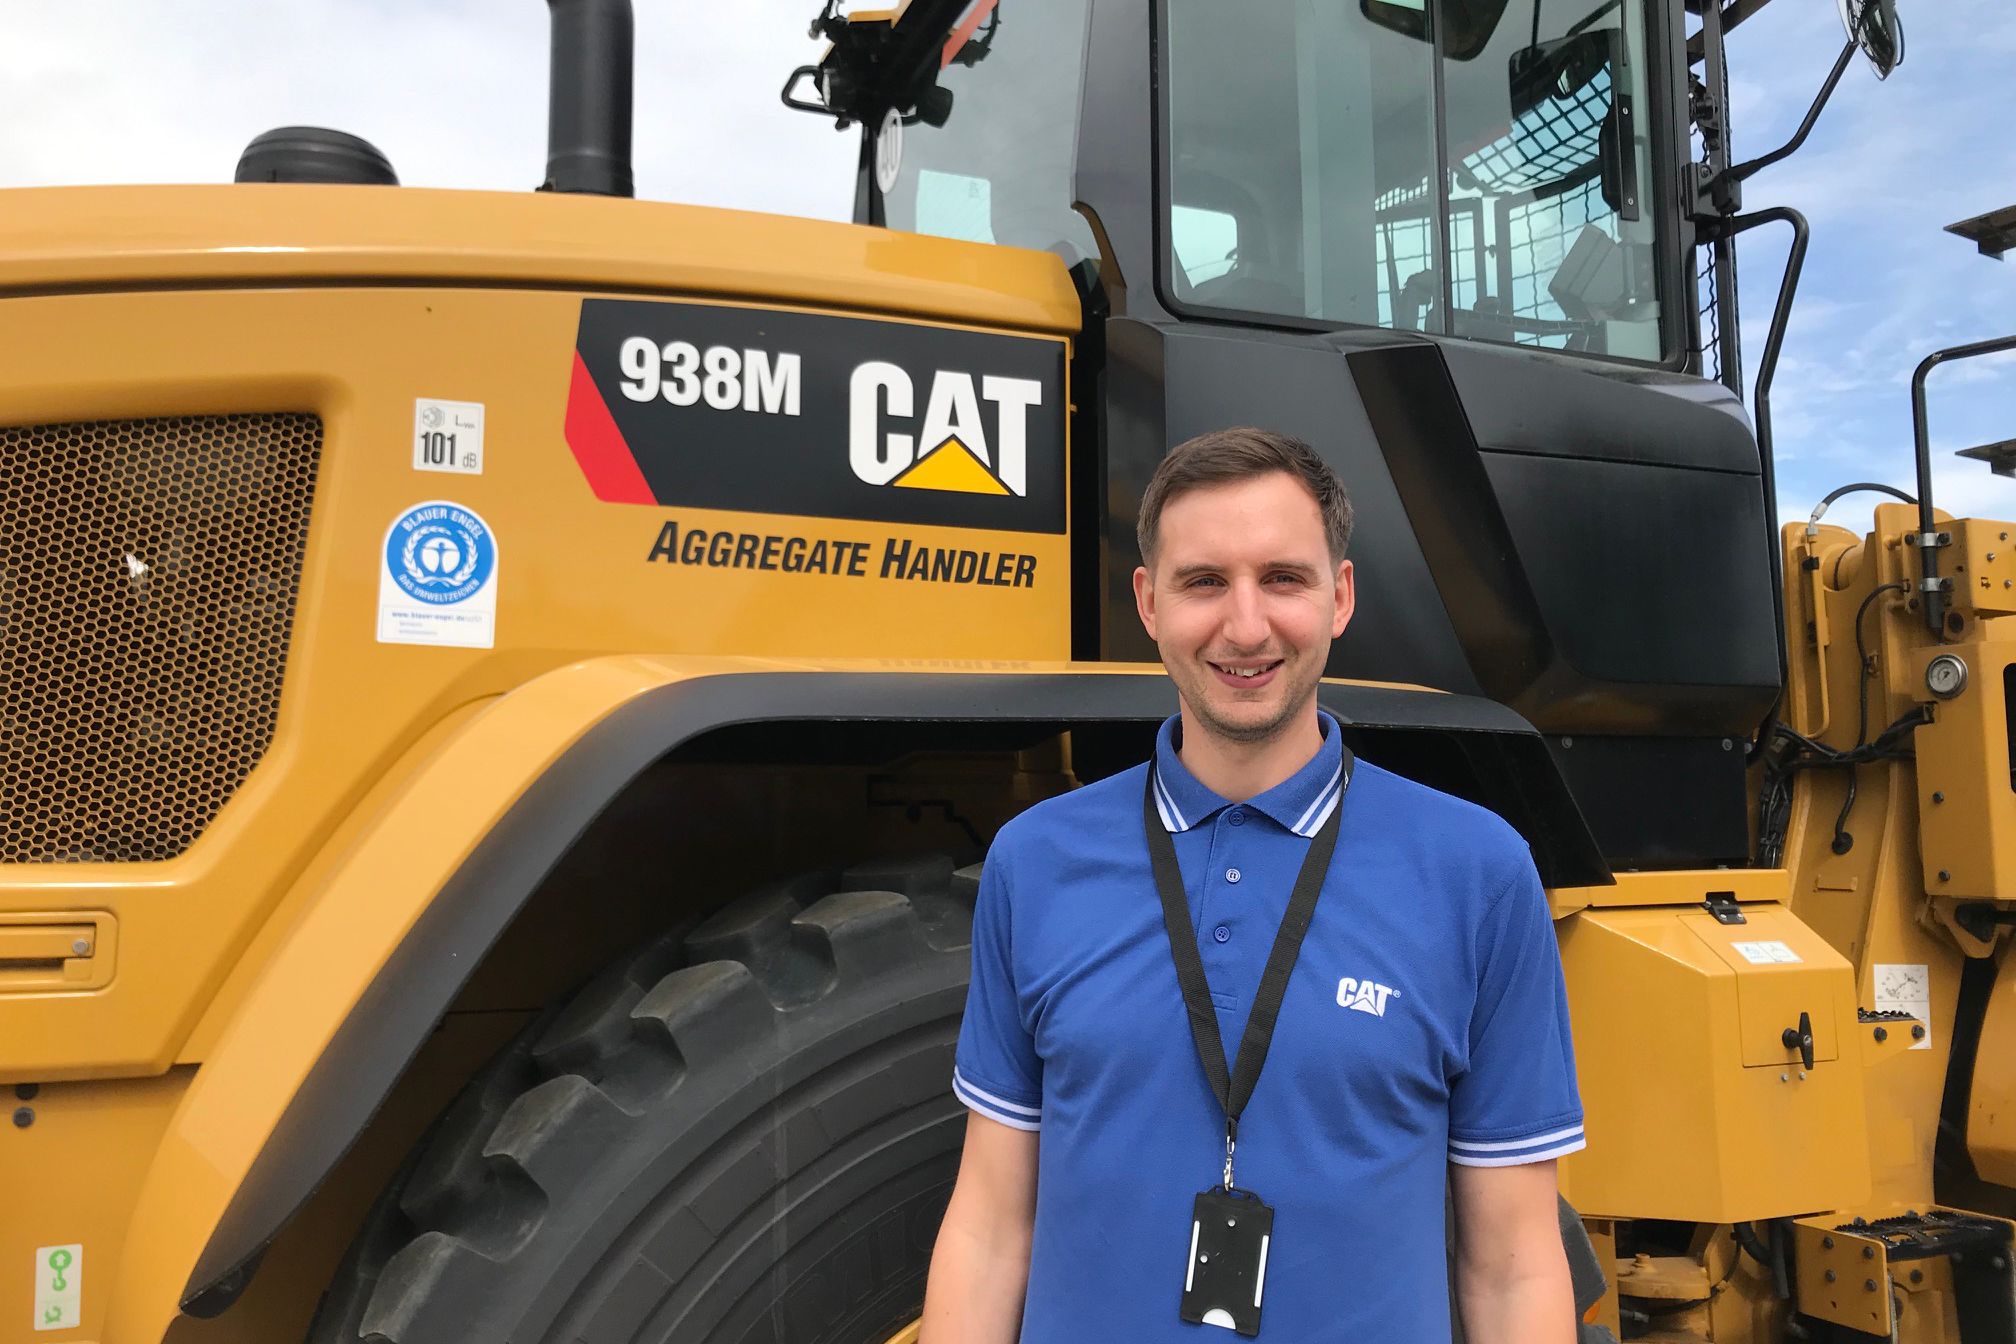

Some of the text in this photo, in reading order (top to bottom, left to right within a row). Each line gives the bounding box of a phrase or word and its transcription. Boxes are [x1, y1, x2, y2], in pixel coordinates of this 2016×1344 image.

[618, 336, 801, 416] 938M
[421, 431, 456, 467] 101
[848, 361, 1042, 498] CAT
[463, 452, 477, 469] dB
[401, 507, 484, 540] BLAUER ENGEL
[647, 521, 1038, 588] AGGREGATE HANDLER
